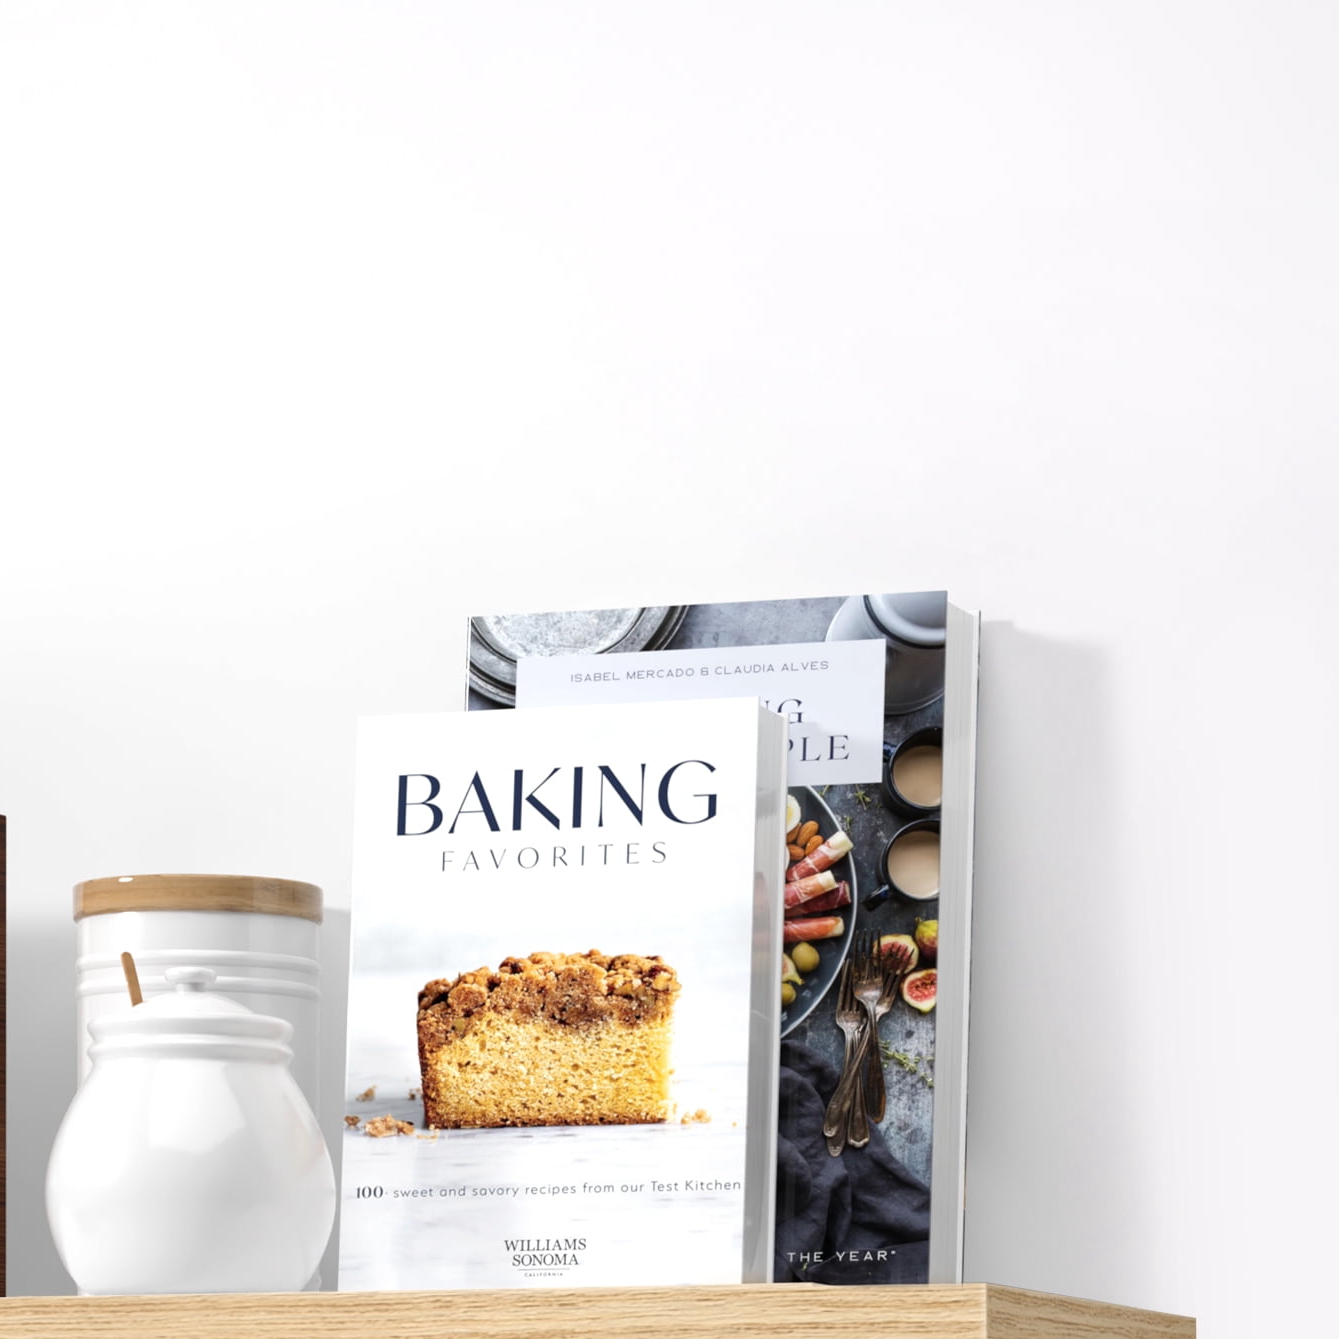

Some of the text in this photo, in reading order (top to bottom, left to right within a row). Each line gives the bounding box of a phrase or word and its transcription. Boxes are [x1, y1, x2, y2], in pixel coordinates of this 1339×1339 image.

[570, 672, 621, 683] ISABEL
[626, 668, 695, 681] MERCADO
[714, 663, 775, 676] CLAUDIA
[781, 660, 830, 672] ALVES
[396, 760, 718, 836] BAKING
[441, 841, 667, 872] FAVORITES
[392, 1187, 433, 1199] sweet
[439, 1185, 467, 1197] and
[472, 1185, 520, 1198] savory
[525, 1184, 577, 1197] recipes
[583, 1182, 615, 1193] from
[620, 1183, 644, 1193] our
[650, 1180, 680, 1192] Test
[685, 1179, 742, 1191] Kitchen
[503, 1238, 587, 1252] WILLIAMS
[511, 1253, 580, 1267] SONOMA
[786, 1251, 824, 1263] THE
